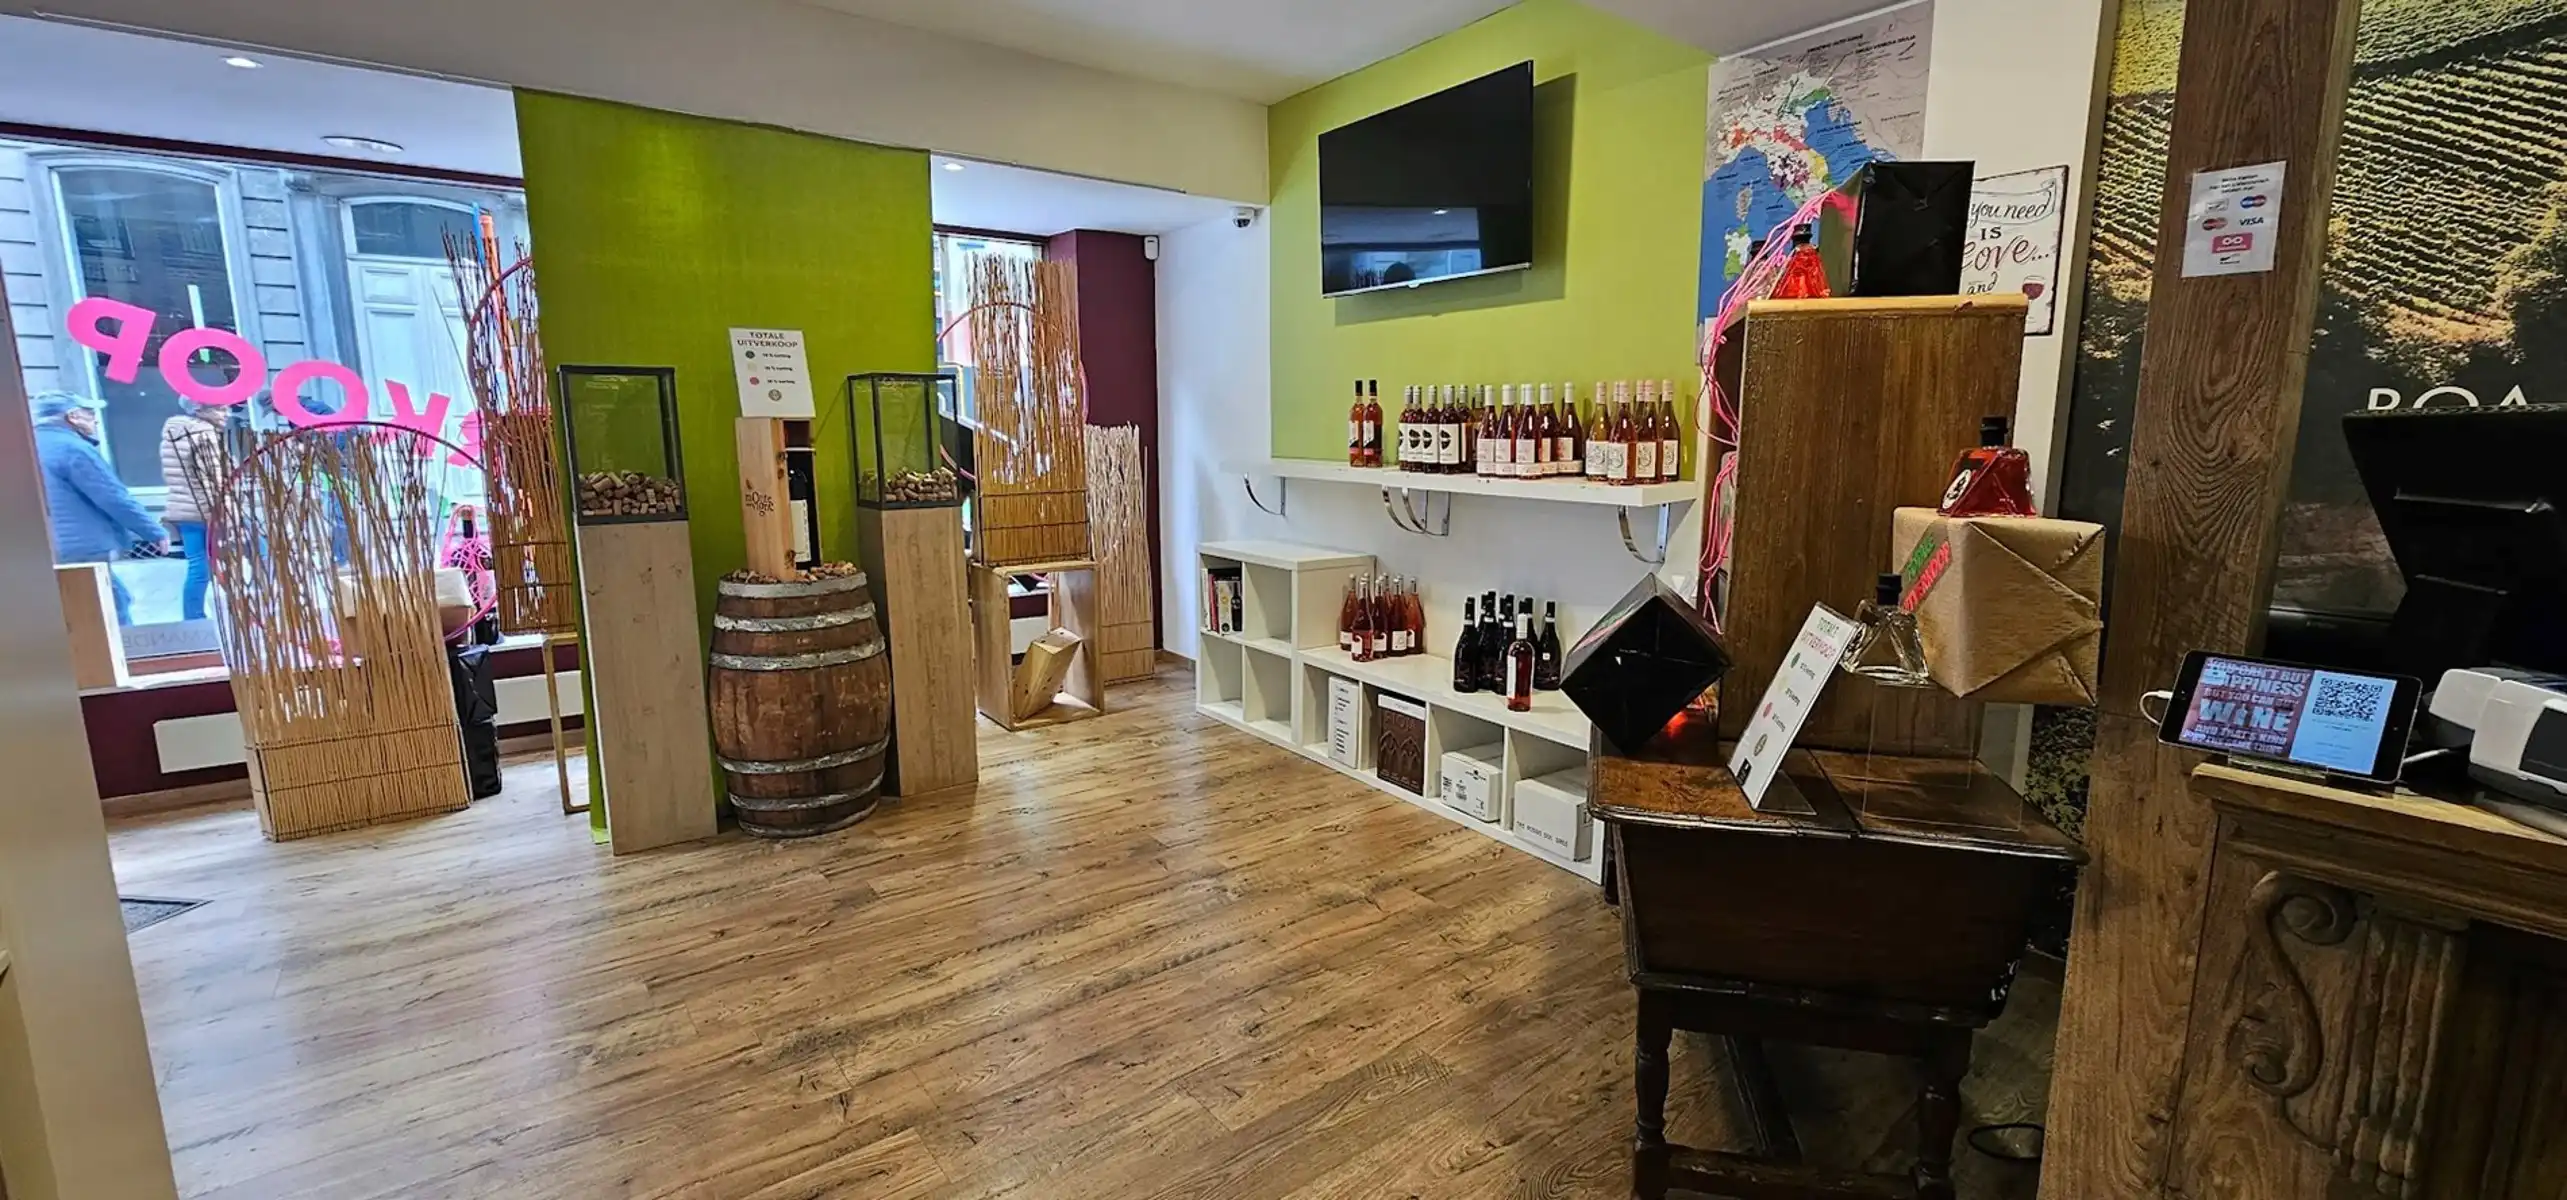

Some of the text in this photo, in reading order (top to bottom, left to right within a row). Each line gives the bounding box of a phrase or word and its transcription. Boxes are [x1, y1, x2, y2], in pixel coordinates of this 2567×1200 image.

[1971, 190, 2051, 228] you need
[2239, 217, 2264, 226] VISA
[1981, 227, 2002, 240] IS
[1967, 271, 1998, 295] and
[750, 331, 784, 340] TOTALE
[737, 339, 798, 348] UITVERKOOP
[2281, 671, 2311, 684] BUY
[2224, 674, 2304, 698] PPINESS
[2204, 687, 2226, 700] BUT
[2227, 690, 2250, 702] YOU
[2200, 698, 2294, 731] WINE
